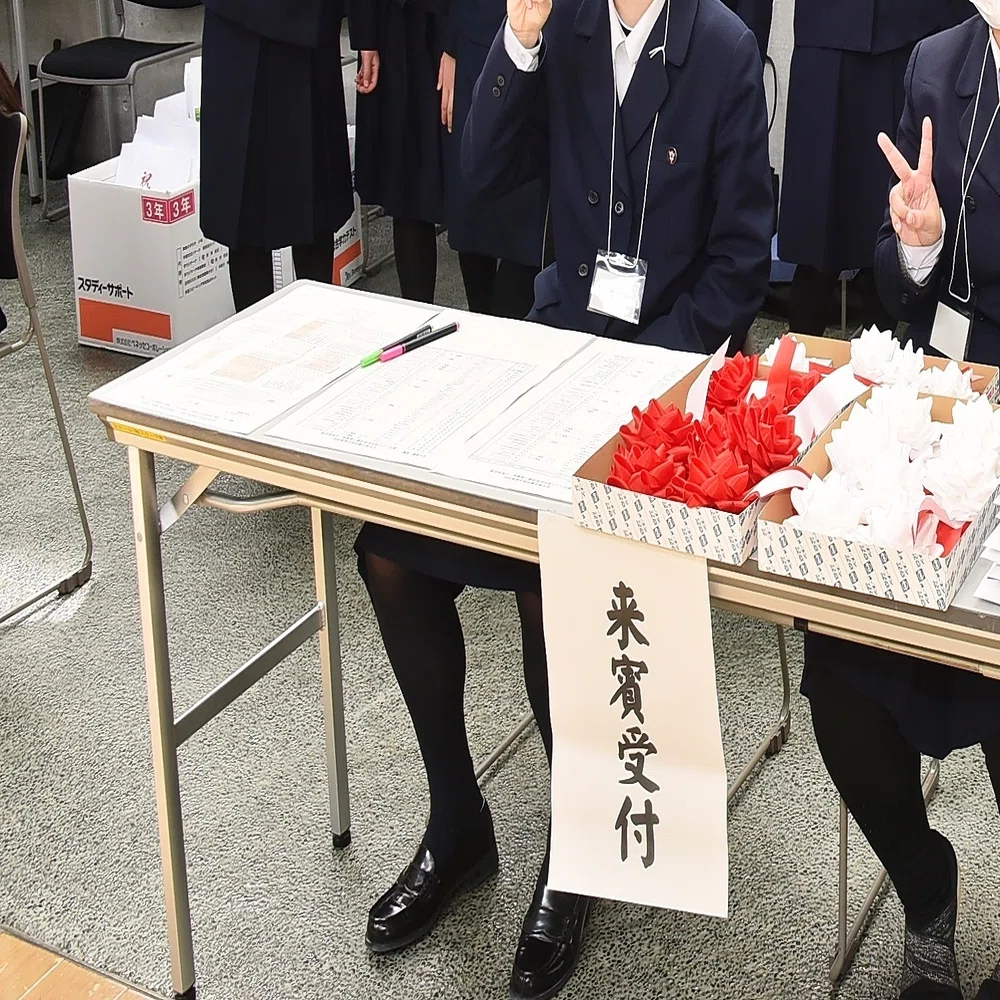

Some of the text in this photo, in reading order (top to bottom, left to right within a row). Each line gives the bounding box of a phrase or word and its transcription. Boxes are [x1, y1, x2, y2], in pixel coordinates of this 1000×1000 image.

[140, 171, 153, 189] 祝
[146, 201, 165, 220] 3年
[171, 195, 192, 218] 3年
[77, 277, 134, 299] スタディーサポート
[606, 580, 660, 869] 来賓受付
